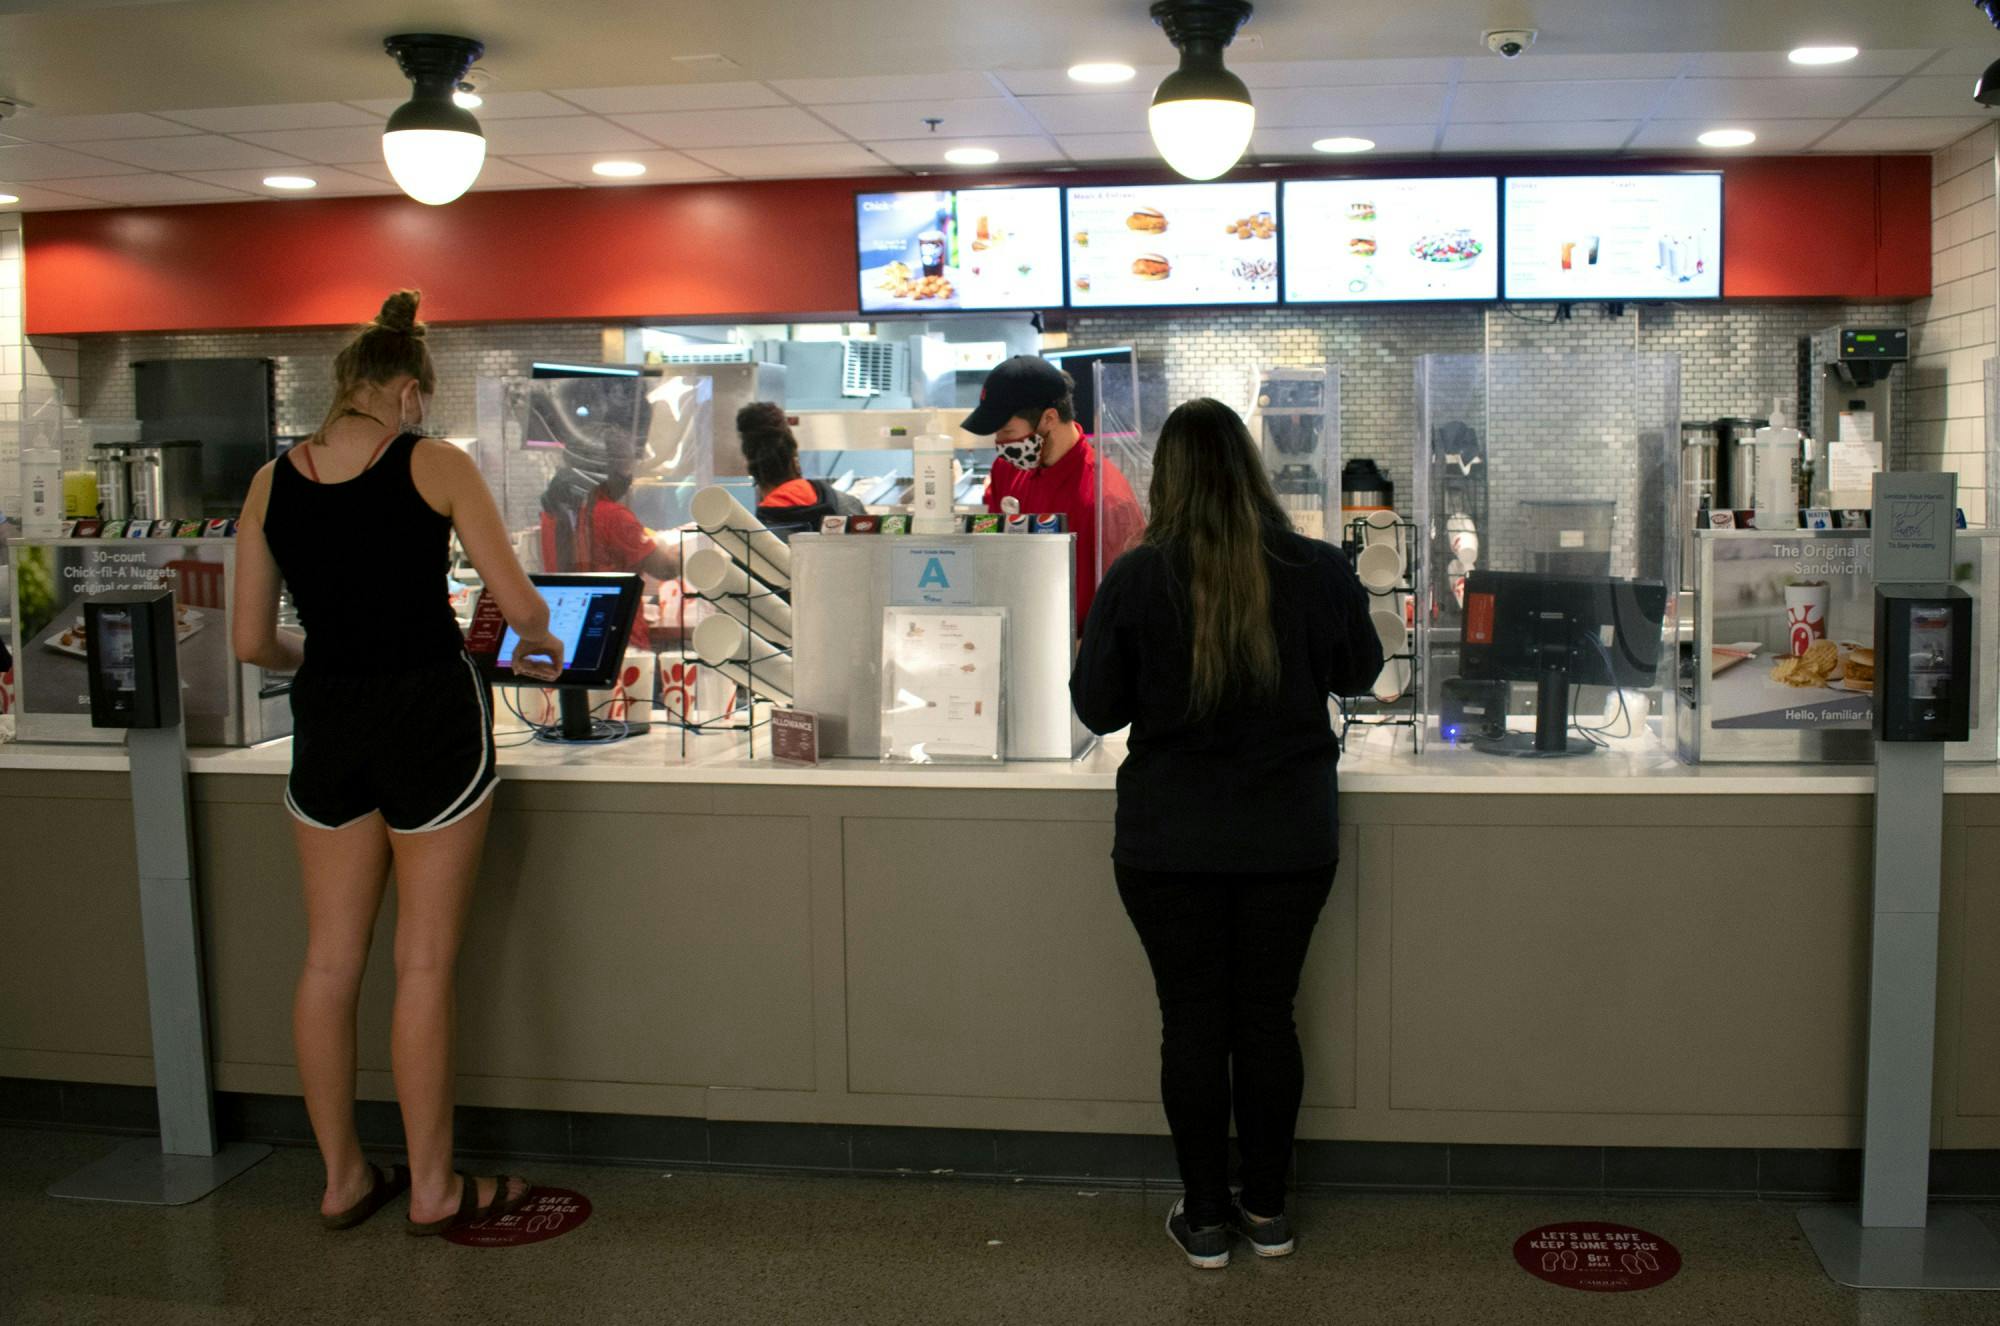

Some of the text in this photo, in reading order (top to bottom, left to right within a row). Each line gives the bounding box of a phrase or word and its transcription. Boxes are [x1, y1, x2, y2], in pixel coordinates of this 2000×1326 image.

[91, 551, 147, 563] 30-count
[1772, 543, 1799, 557] The
[1803, 543, 1859, 561] Original
[63, 566, 177, 581] Chick-fil-A Nuggets
[918, 557, 950, 588] A
[1793, 561, 1863, 575] Sandwich
[73, 581, 115, 595] original
[1785, 709, 1819, 722] Hello,
[1821, 709, 1864, 721] familiar
[772, 717, 813, 732] ALLOWANCE
[539, 1196, 573, 1204] SAFE
[536, 1204, 580, 1213] SPACE
[1541, 1231, 1641, 1241] LET'S BE SAFE
[1530, 1240, 1659, 1251] KEEP SOME SPACE
[1587, 1253, 1609, 1263] 6FT
